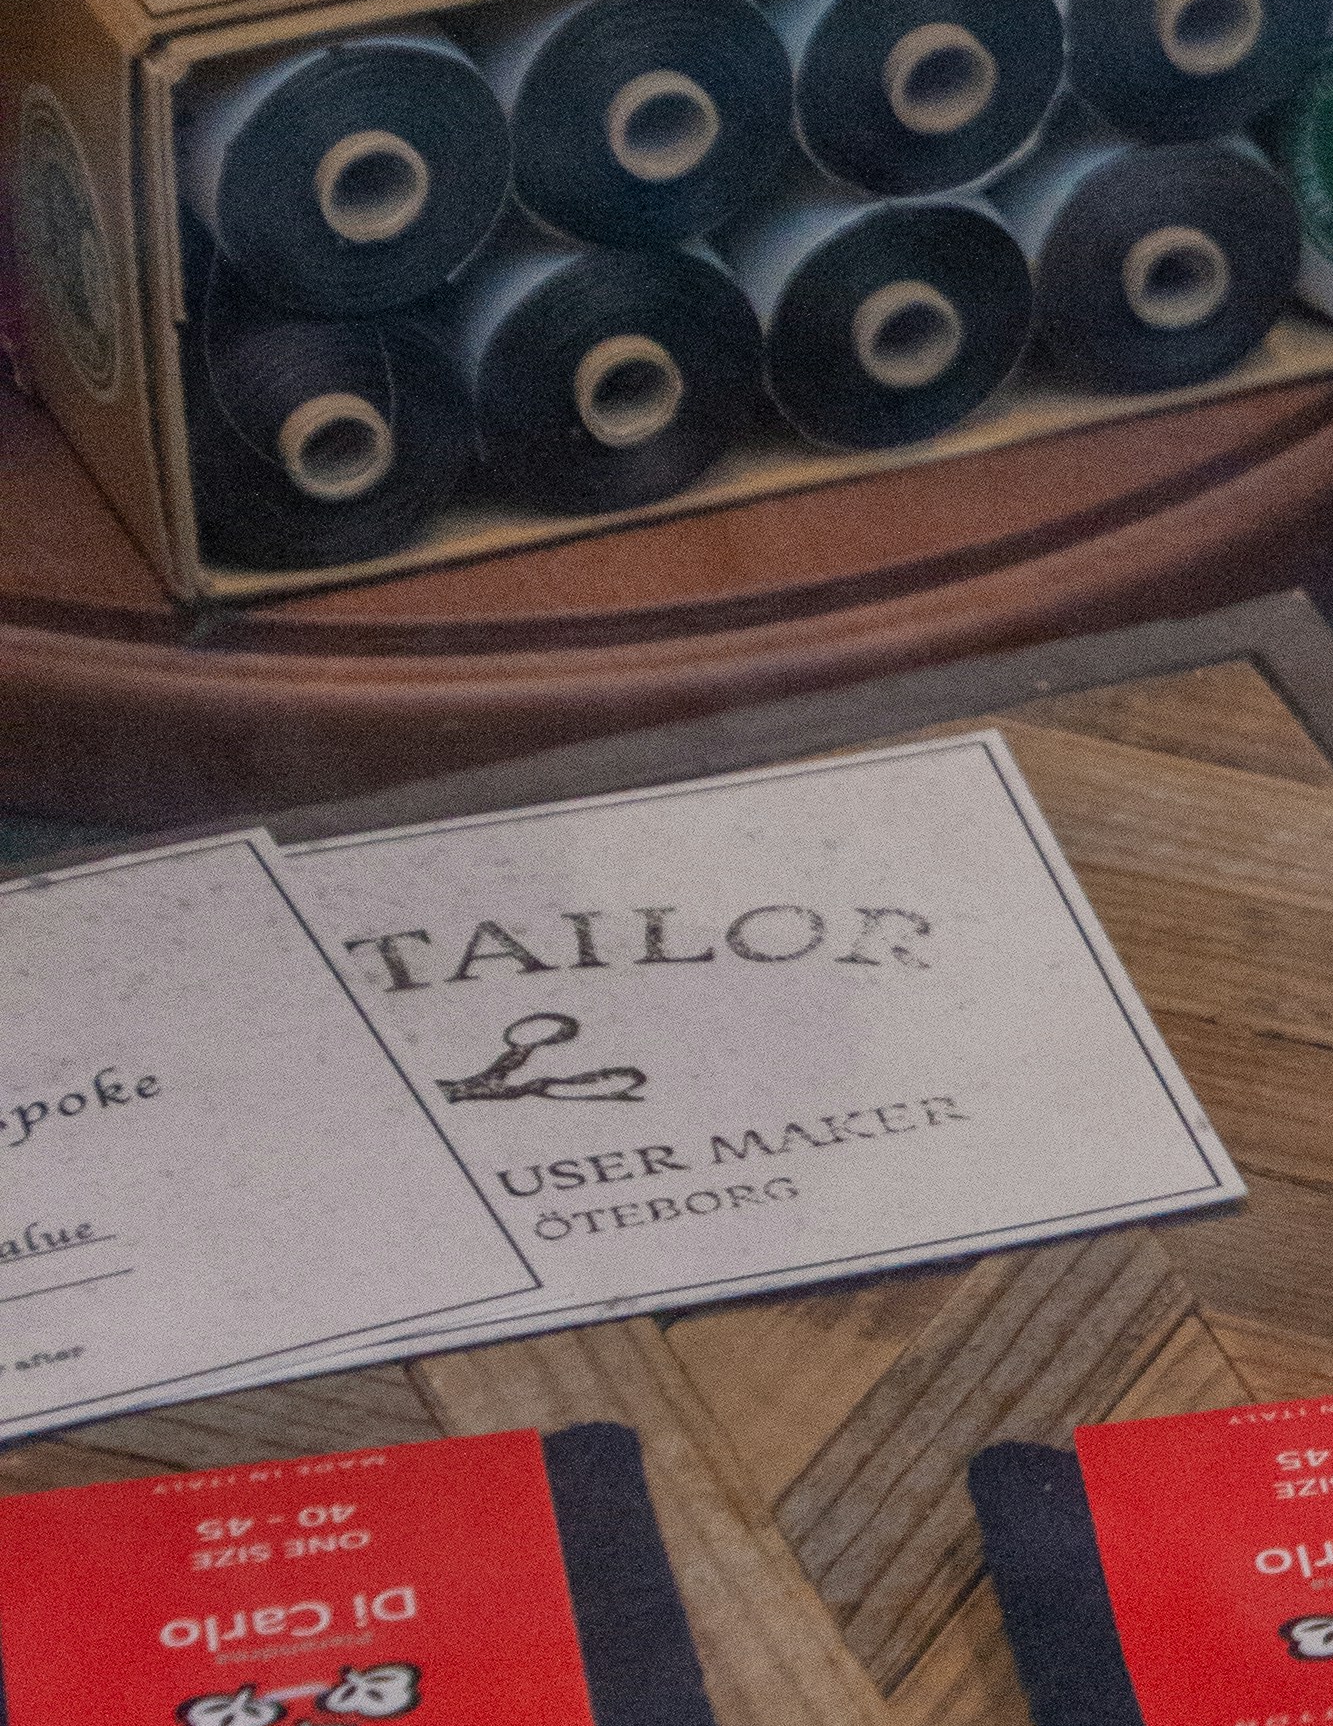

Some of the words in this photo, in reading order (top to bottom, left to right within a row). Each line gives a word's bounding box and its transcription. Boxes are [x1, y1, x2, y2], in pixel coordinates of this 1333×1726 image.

[344, 904, 932, 993] TAILOR
[0, 1068, 162, 1147] poke
[710, 1096, 972, 1163] MAKER
[1226, 1406, 1307, 1427] ITALY
[294, 1453, 387, 1478] MADE
[1275, 1446, 1331, 1471] 45
[149, 1473, 237, 1496] ITALY
[248, 1467, 283, 1484] IN
[195, 1515, 255, 1543] 45
[297, 1501, 358, 1529] 40
[189, 1542, 273, 1572] SIZE
[282, 1527, 373, 1562] ONE
[352, 1584, 418, 1628] Di
[158, 1599, 333, 1654] Carlo
